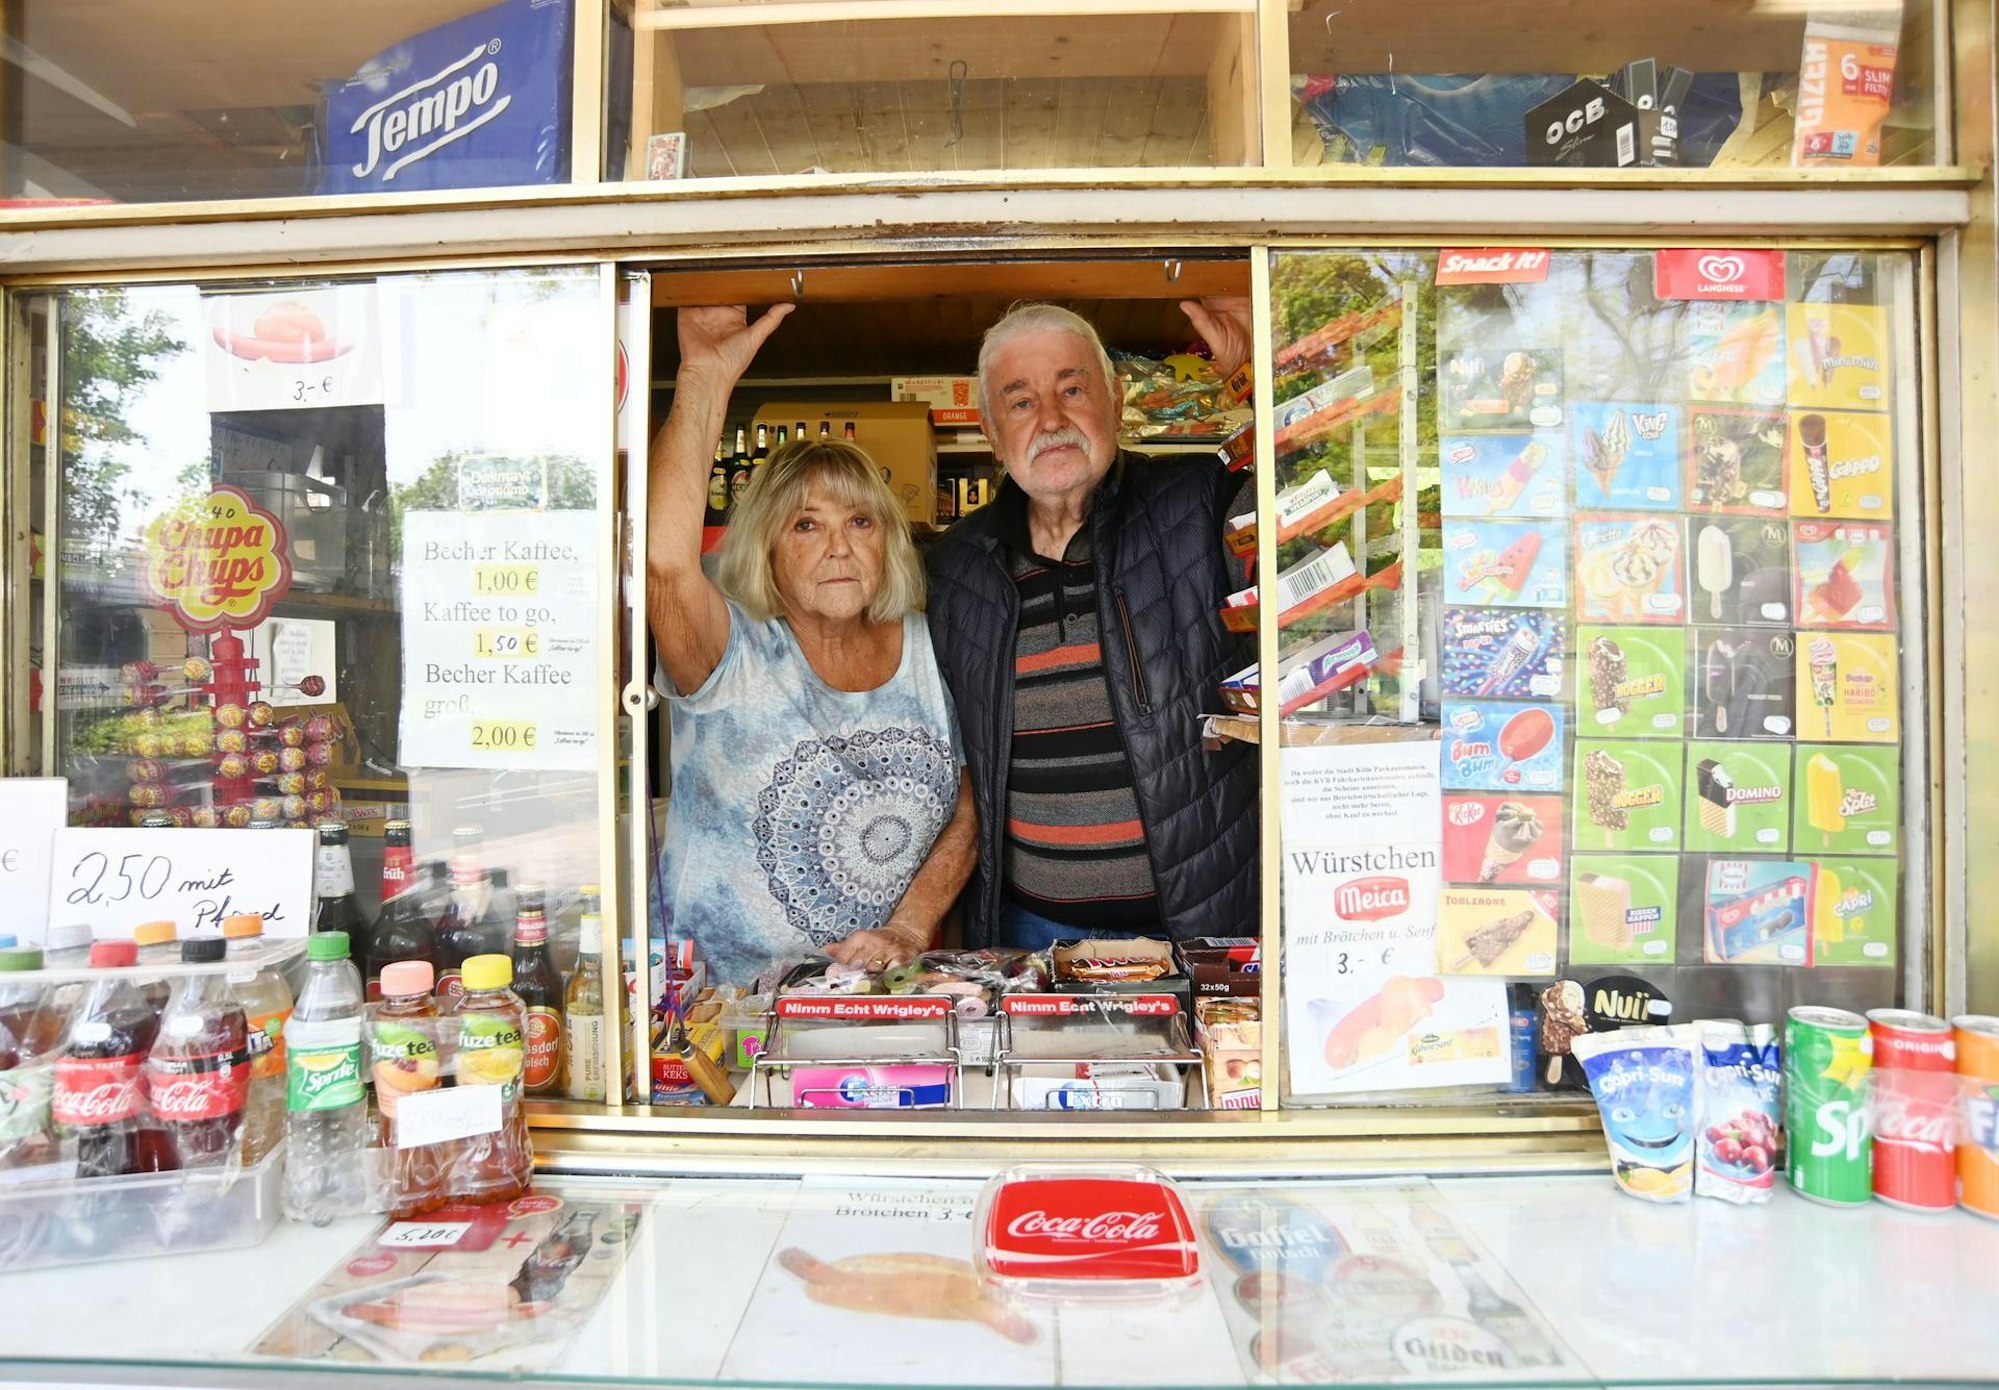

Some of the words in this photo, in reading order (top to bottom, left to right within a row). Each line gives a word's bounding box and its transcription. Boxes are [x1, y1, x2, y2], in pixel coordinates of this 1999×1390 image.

[1840, 53, 1859, 81] 6
[1864, 70, 1891, 85] SLIM
[1796, 43, 1828, 129] GIZEH
[351, 62, 499, 178] Tempo
[1546, 97, 1605, 145] OCB
[1441, 252, 1515, 273] Snack
[1697, 284, 1745, 293] LANGNESE
[942, 411, 968, 421] ORANGE
[471, 469, 533, 485] Dallmayr
[1829, 455, 1880, 479] Calippo
[158, 520, 264, 551] Chupa
[424, 540, 497, 561] Becher
[503, 539, 579, 564] Kaffee,
[158, 554, 265, 602] Chups
[475, 570, 519, 594] 1,00
[525, 569, 540, 591] €
[423, 601, 492, 622] Kaffee
[498, 604, 518, 622] to
[524, 606, 557, 628] go,
[1454, 618, 1508, 637] SMARTIES
[475, 632, 518, 656] 1,50
[524, 632, 539, 654] €
[424, 663, 497, 684] Becher
[503, 663, 573, 684] Kaffee
[1843, 687, 1875, 698] HARIBO
[471, 725, 517, 749] 2,00
[523, 725, 537, 747] €
[1451, 739, 1490, 762] Bum
[1355, 765, 1372, 774] Köln
[1458, 758, 1498, 779] Bum
[1726, 785, 1782, 801] DOMINO
[1453, 805, 1482, 822] KitKat
[1290, 846, 1437, 876] Würstchen
[66, 851, 173, 908] 2,50
[178, 868, 235, 892] mit
[1340, 885, 1406, 915] Meica
[1445, 895, 1506, 906] TOBLERONE
[1296, 932, 1319, 947] mit
[1323, 927, 1385, 945] Brötchen
[1388, 930, 1400, 940] u.
[1405, 922, 1437, 941] Senf
[1380, 946, 1395, 965] €
[1200, 983, 1230, 993] 32x50g
[785, 1003, 831, 1014] Nimm
[834, 1003, 871, 1015] Echt
[871, 1003, 945, 1018] Wrigley's
[1010, 1001, 1057, 1013] Nimm
[1100, 1001, 1171, 1015] Wrigley's
[527, 1038, 559, 1054] ssdorf
[305, 1060, 355, 1094] Sprite
[663, 1070, 688, 1080] KEKS
[1599, 1064, 1686, 1094] Capri-Sun
[847, 1191, 952, 1206] Würstchen
[835, 1205, 929, 1219] Brötchen
[1008, 1210, 1165, 1240] Coca-Cola
[1219, 1222, 1332, 1247] Gaffel
[1403, 1336, 1506, 1369] Gilden
